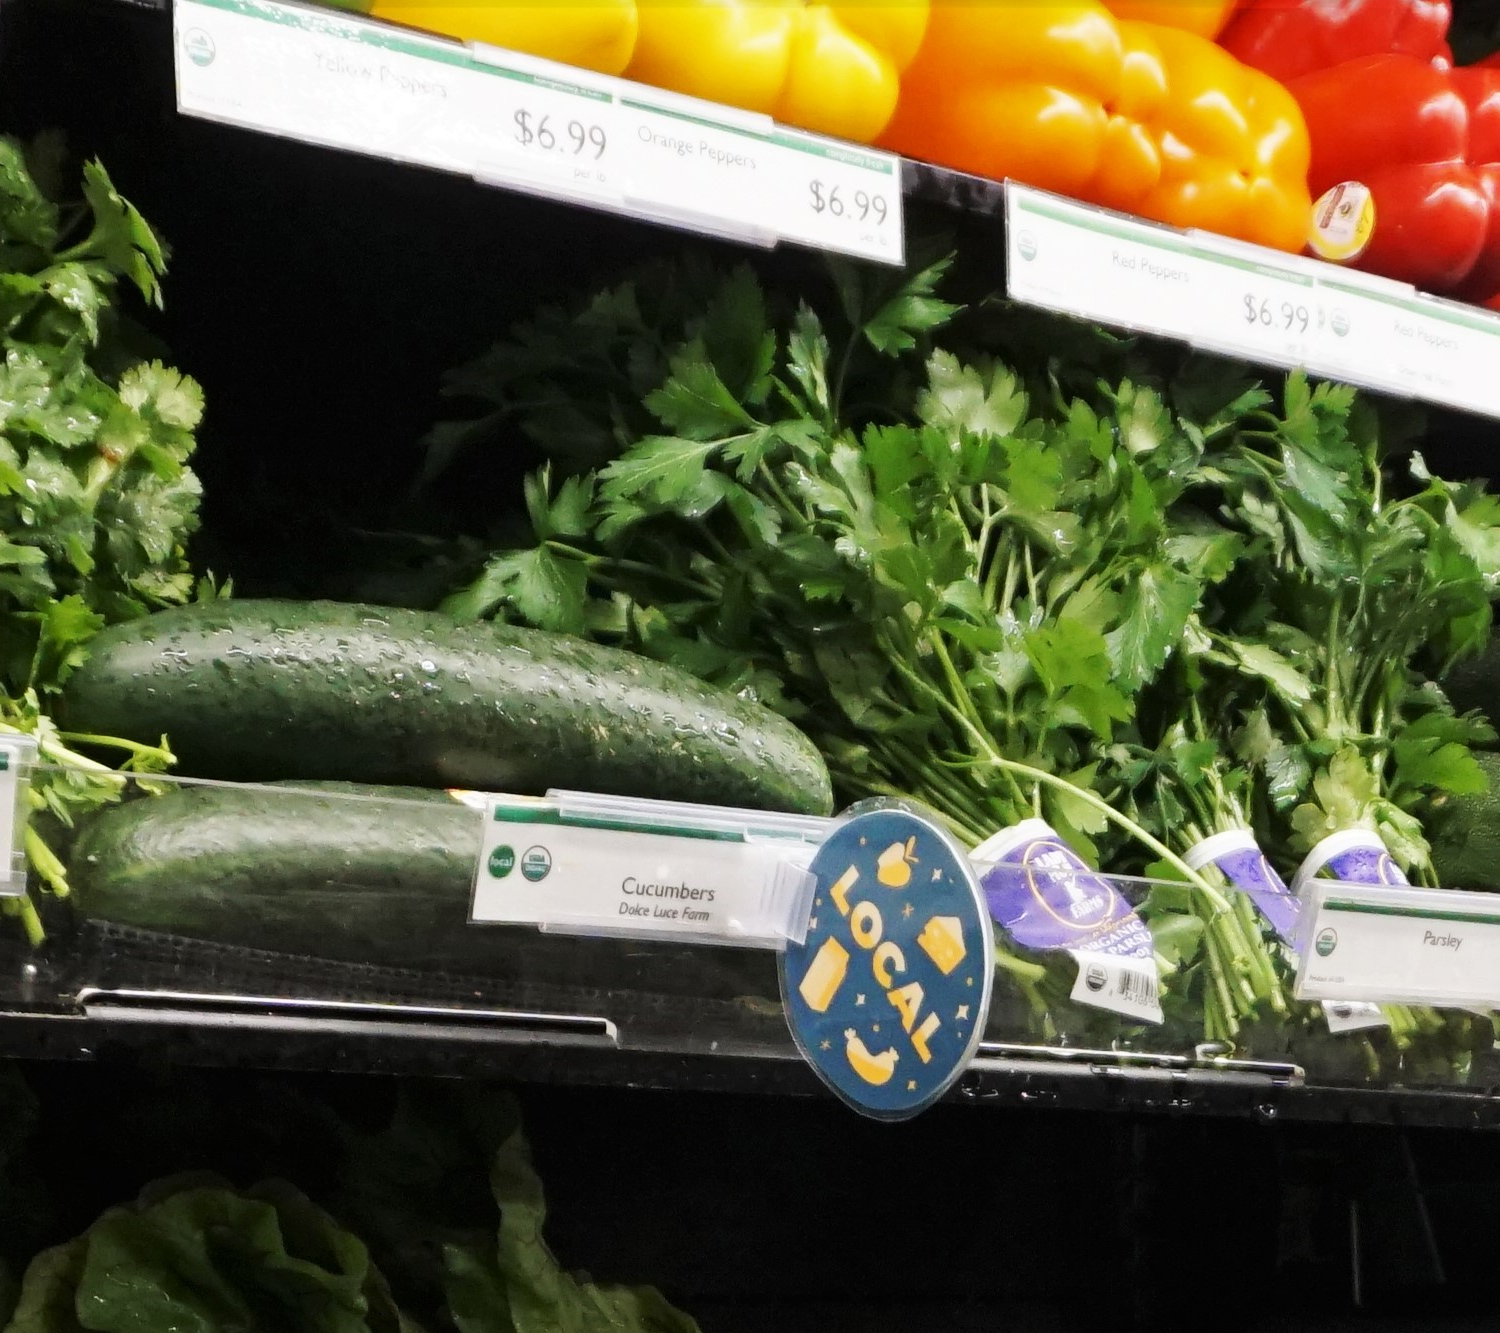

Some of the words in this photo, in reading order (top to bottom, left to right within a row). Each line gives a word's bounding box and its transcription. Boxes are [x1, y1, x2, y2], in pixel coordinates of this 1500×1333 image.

[313, 50, 374, 82] Yellow
[380, 62, 448, 100] Peppers
[514, 108, 607, 162] $6.99
[638, 124, 693, 158] Orange
[698, 138, 757, 171] Peppers
[574, 168, 592, 184] per
[809, 179, 888, 227] $6.99
[1112, 250, 1136, 271] Red
[1141, 256, 1190, 285] Peppers
[1243, 293, 1310, 334] $6.99
[1394, 319, 1416, 339] Red
[1421, 325, 1460, 353] Peppers
[489, 855, 513, 869] local
[622, 877, 716, 902] Cucumbers
[618, 902, 653, 918] Dolce
[656, 904, 682, 919] Luce
[684, 906, 710, 921] Farm
[1079, 920, 1145, 952] ORGANIC
[1423, 930, 1463, 951] Parsley
[830, 864, 942, 1065] LOCAL
